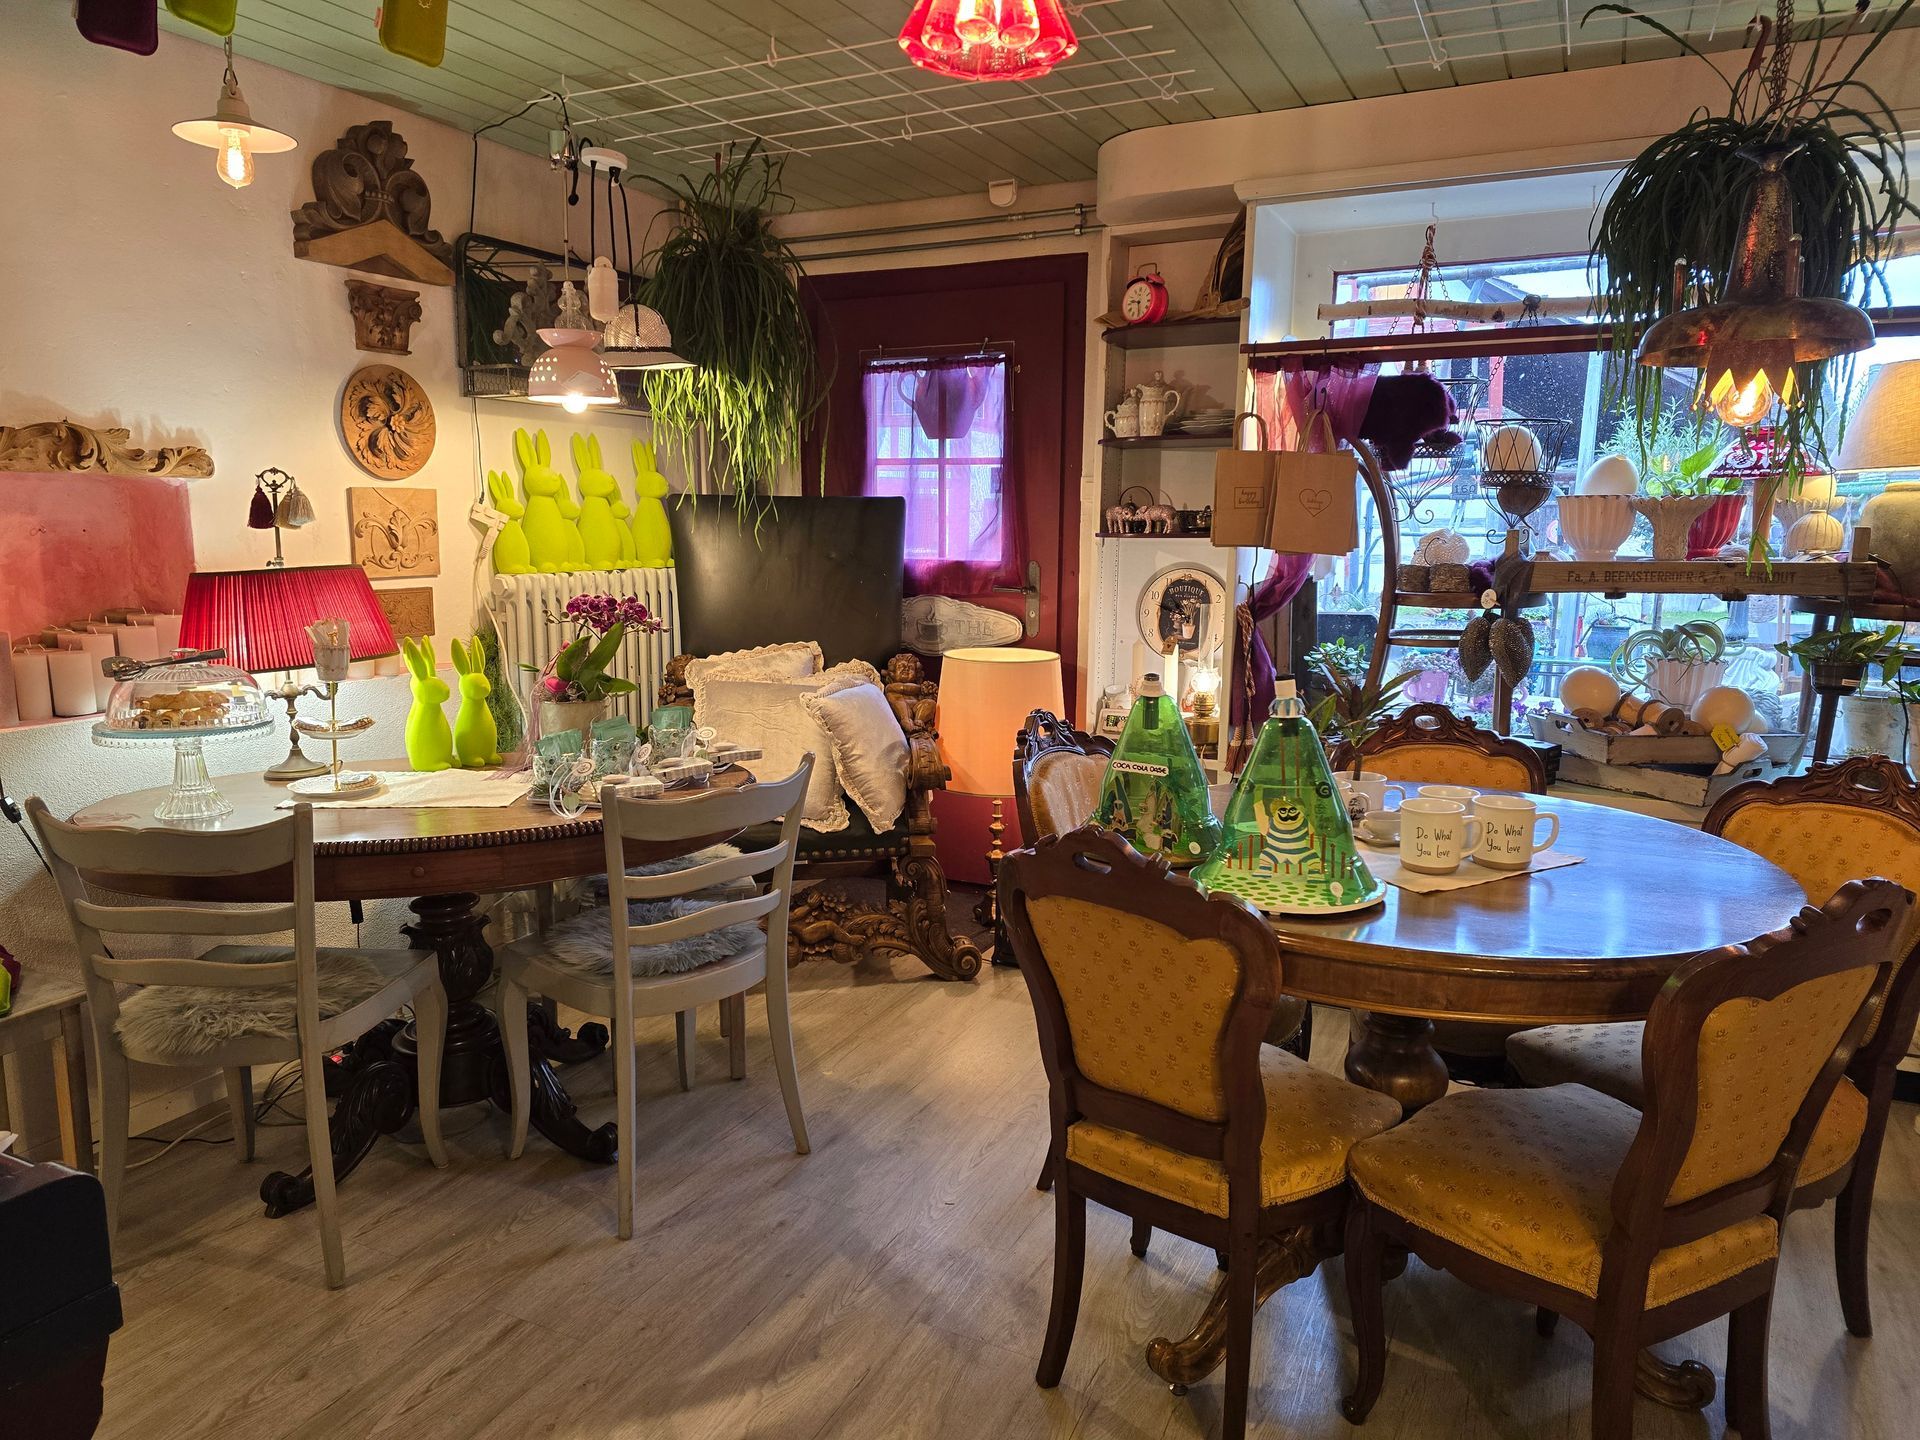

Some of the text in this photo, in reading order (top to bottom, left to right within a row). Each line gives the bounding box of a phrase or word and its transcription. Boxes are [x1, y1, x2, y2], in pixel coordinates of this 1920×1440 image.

[1151, 591, 1159, 600] 10
[1169, 585, 1205, 596] BOUTIQUE
[1216, 594, 1222, 603] 2
[1144, 609, 1150, 617] 9
[1148, 628, 1154, 637] 8
[1112, 761, 1131, 770] COCA
[1132, 764, 1149, 772] COLA
[1416, 826, 1453, 841] Do What
[1486, 821, 1524, 837] Do What
[1416, 843, 1450, 858] You Love
[1486, 838, 1521, 854] You Love
